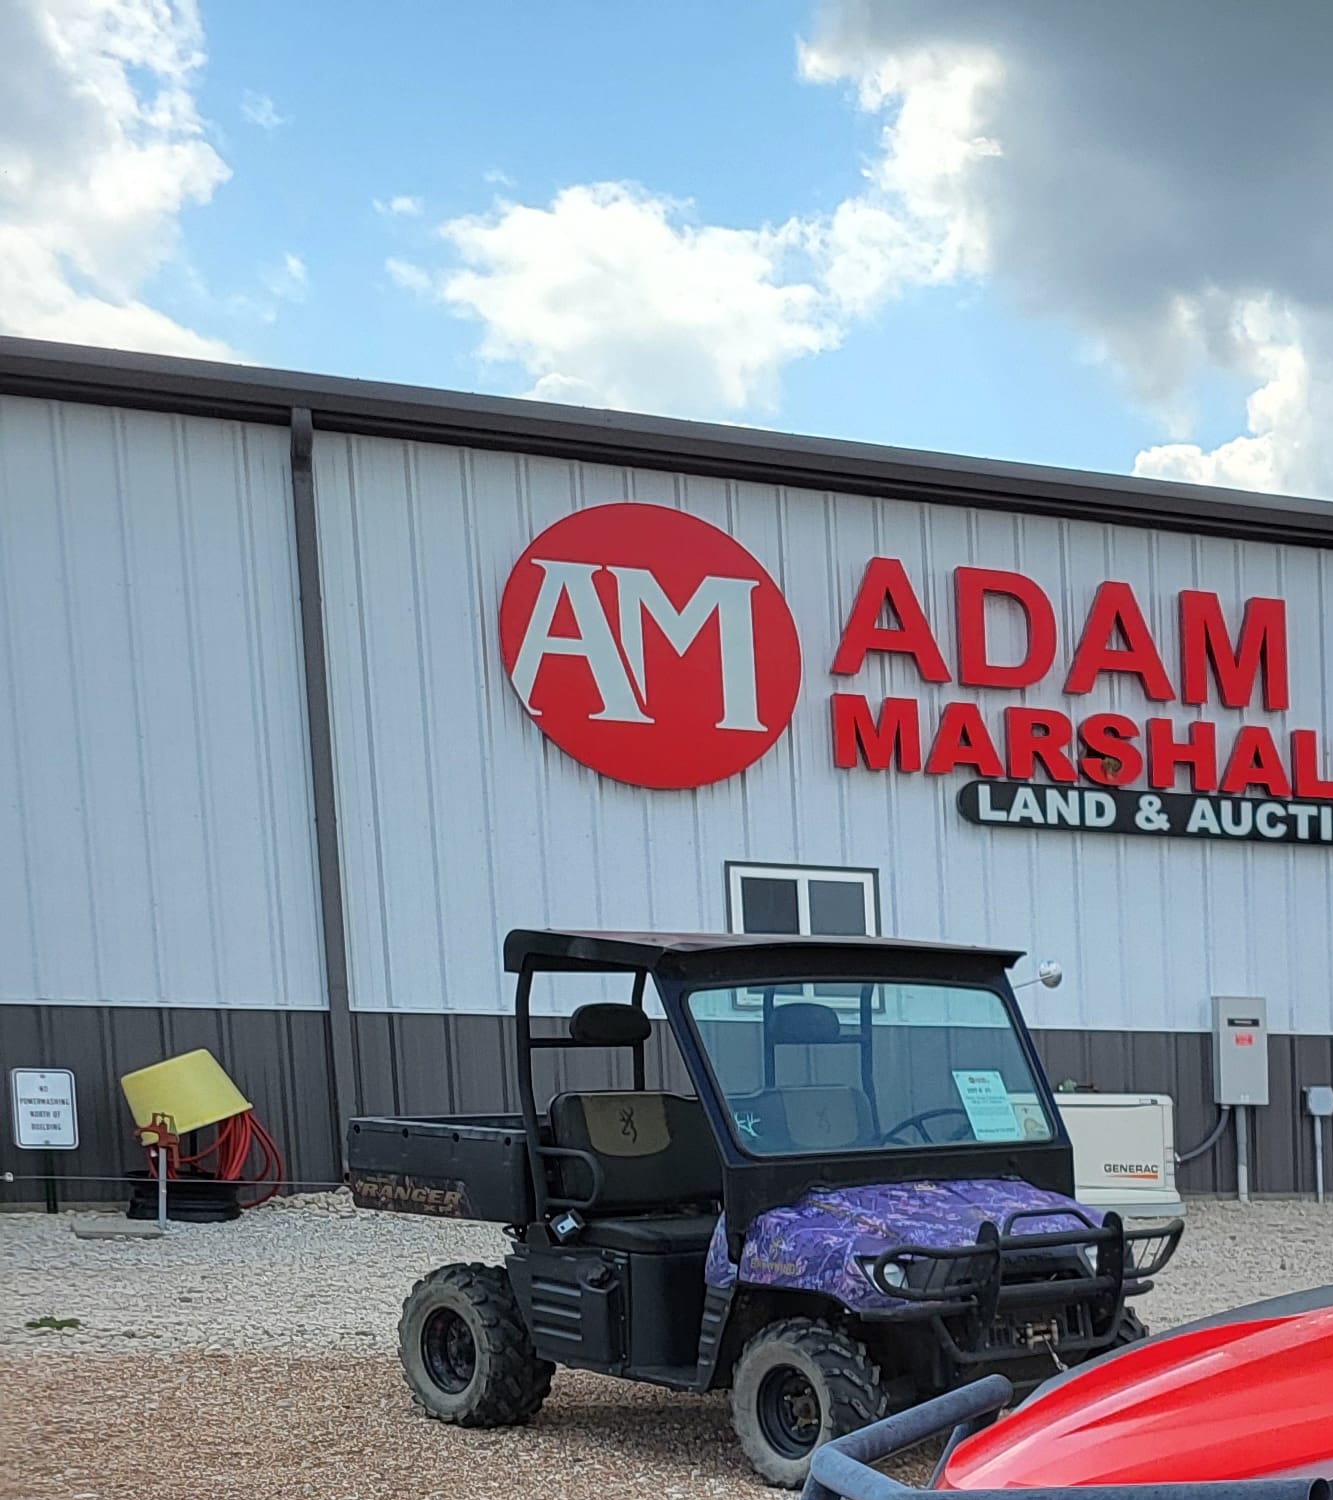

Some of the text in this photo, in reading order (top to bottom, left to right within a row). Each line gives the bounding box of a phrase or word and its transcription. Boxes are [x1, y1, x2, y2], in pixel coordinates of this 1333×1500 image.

[510, 558, 768, 732] AM
[831, 557, 1289, 712] ADAM
[978, 784, 1116, 829] LAND
[1135, 796, 1170, 831] &
[1104, 1163, 1158, 1173] GENERAC
[361, 1183, 462, 1206] RANGER
